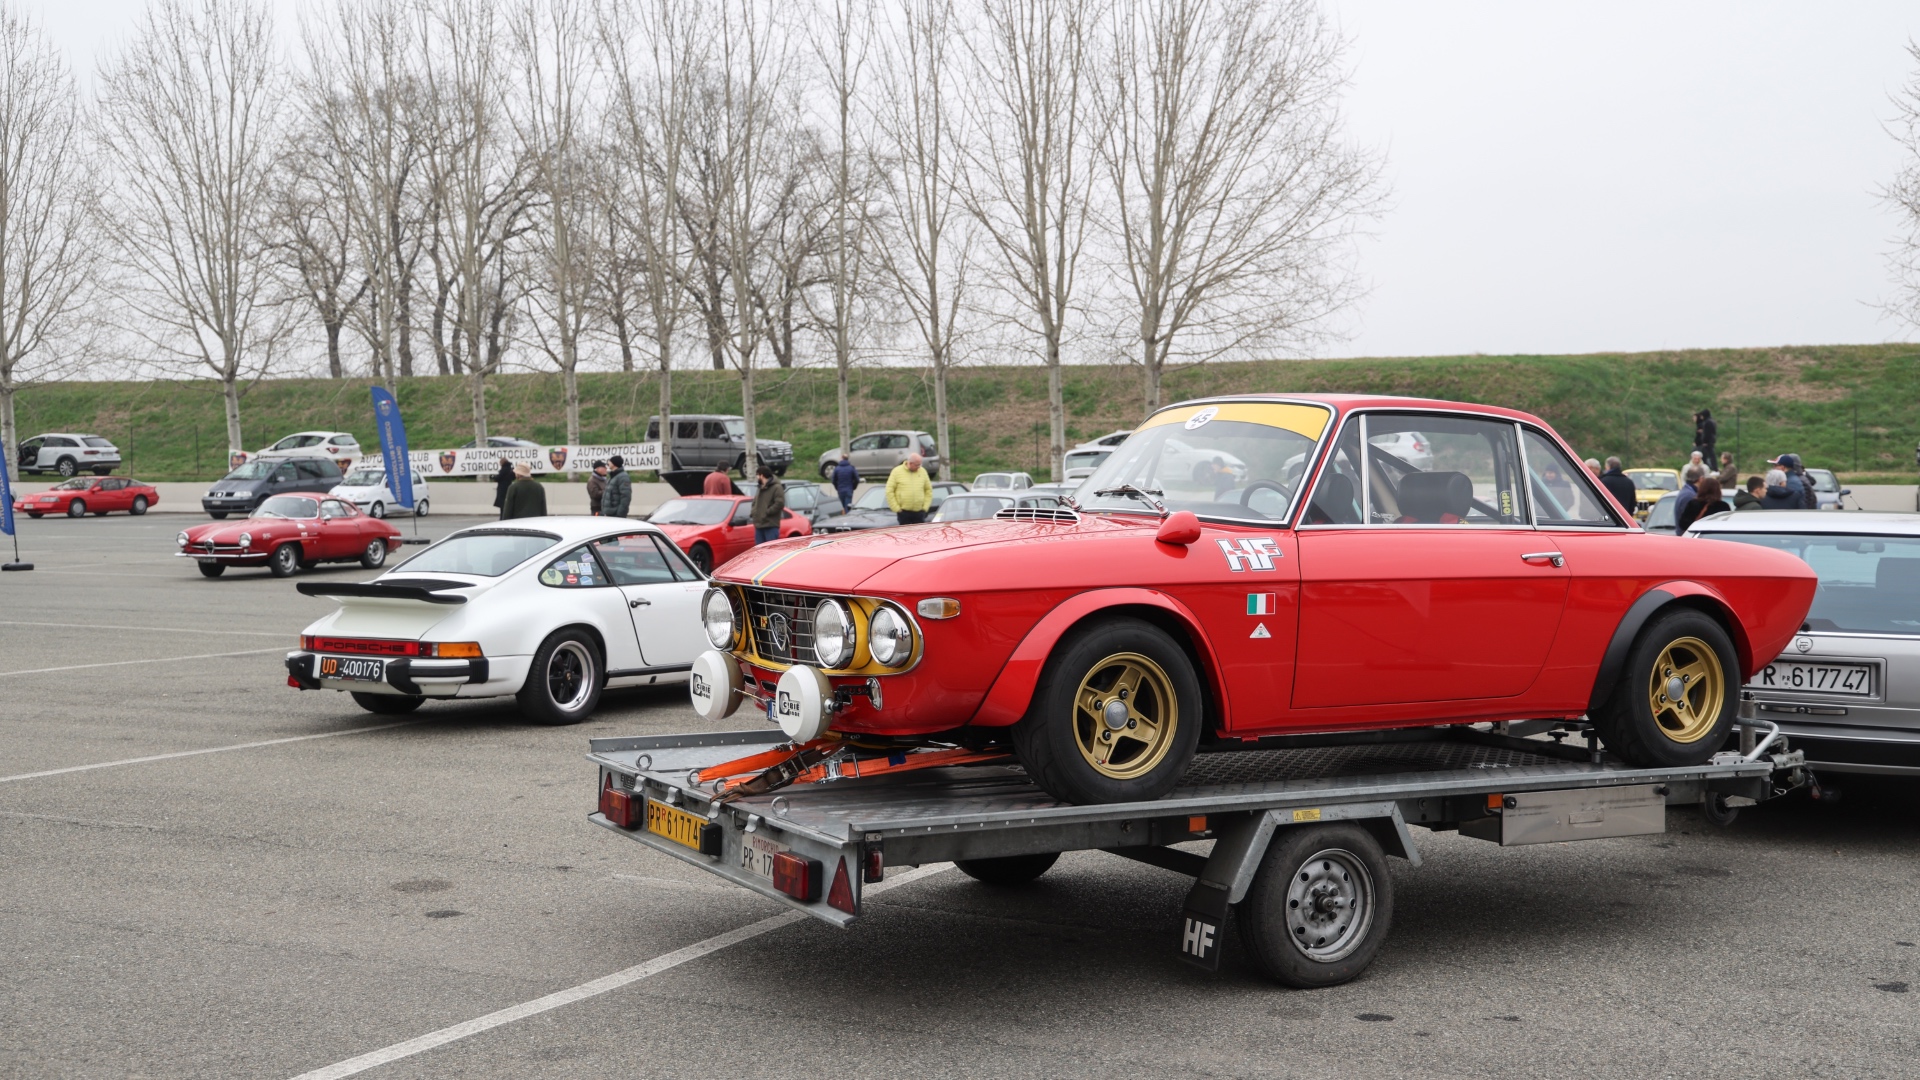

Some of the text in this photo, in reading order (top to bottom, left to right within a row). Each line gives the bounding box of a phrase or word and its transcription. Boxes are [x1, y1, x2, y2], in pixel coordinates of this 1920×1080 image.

[360, 452, 429, 464] AUTOCLUB
[465, 449, 538, 460] AUTOMOTOCLUB
[577, 445, 655, 457] AUTOMOTOCLUB
[460, 462, 498, 472] STORICO
[623, 456, 660, 467] ALIANO
[1501, 492, 1511, 514] OMP
[1216, 537, 1283, 572] HF
[323, 641, 405, 652] PORSCHE
[322, 658, 380, 677] UD 400176
[1792, 667, 1867, 690] 617747
[667, 810, 705, 845] 61774
[742, 846, 773, 876] PR 17
[1182, 918, 1215, 958] HF
